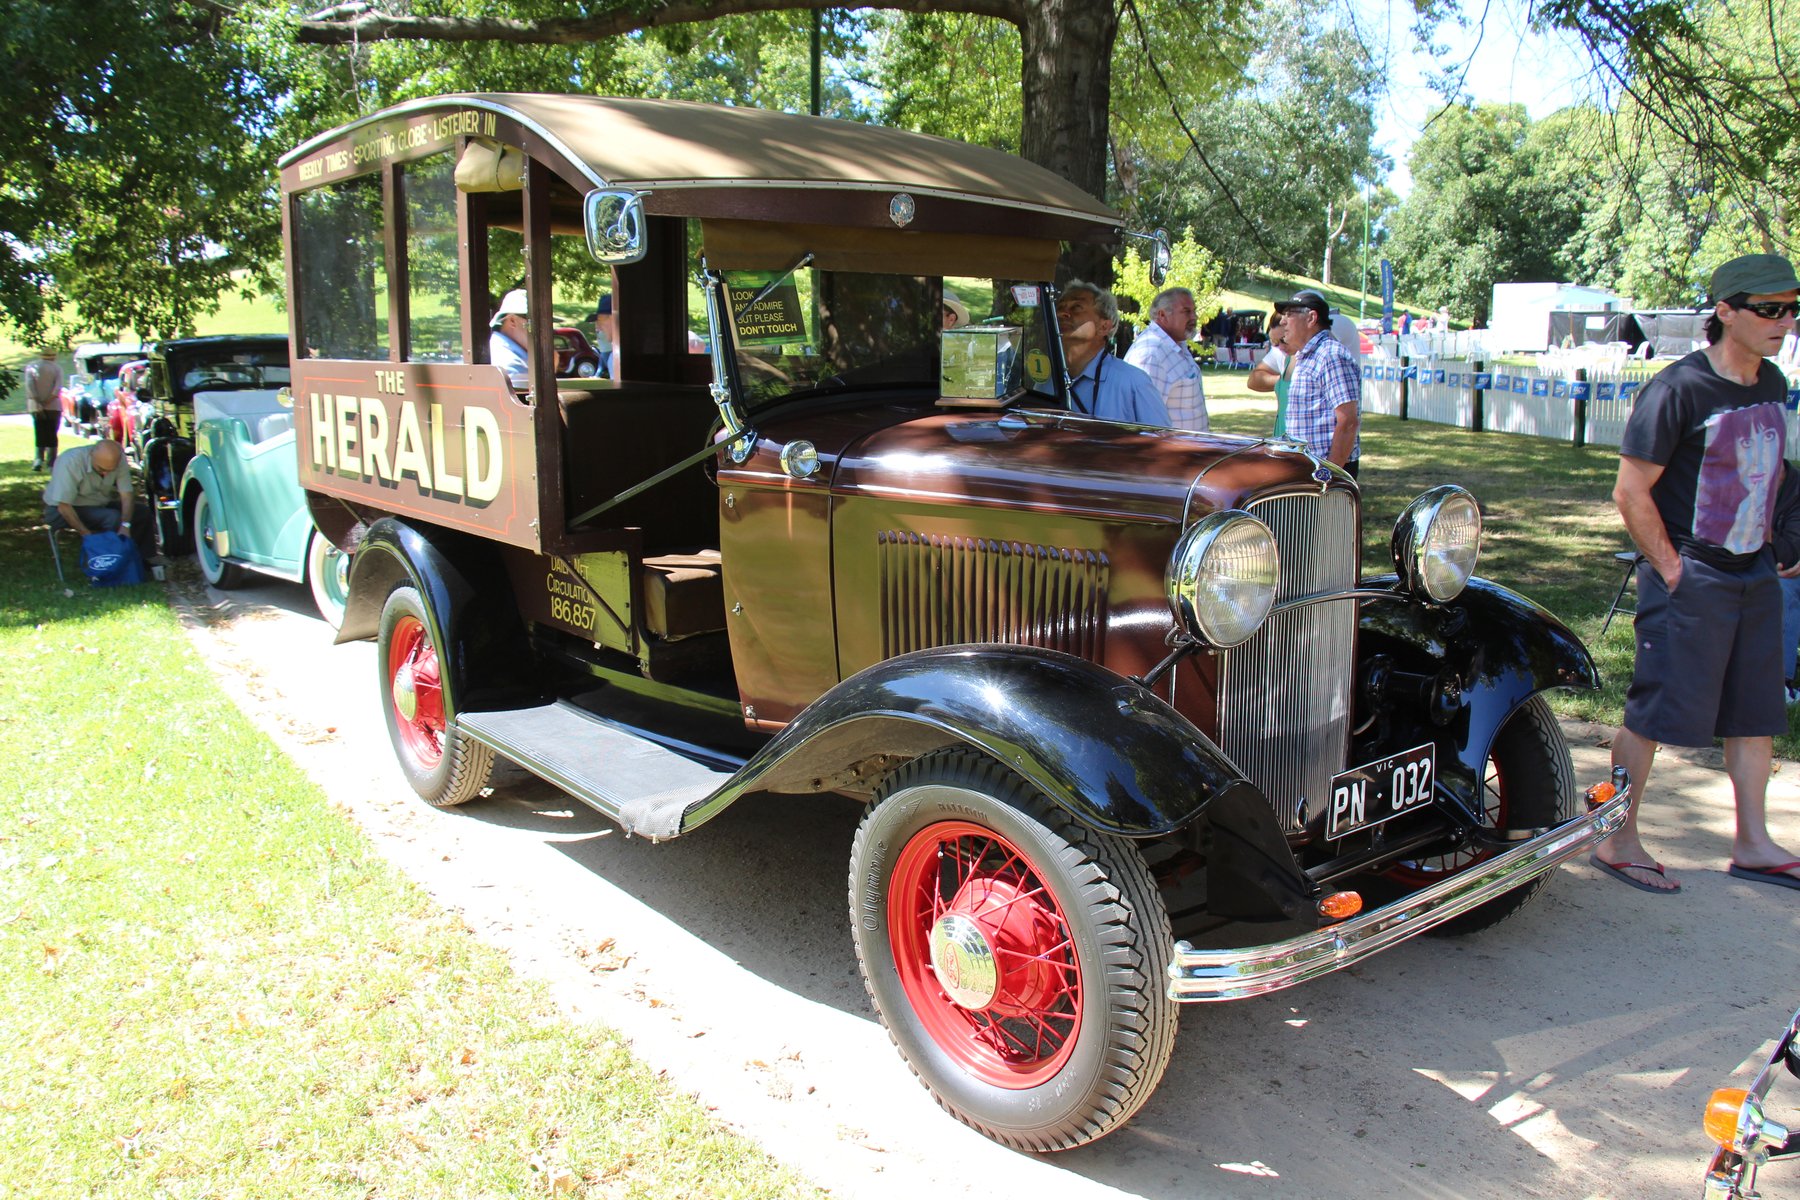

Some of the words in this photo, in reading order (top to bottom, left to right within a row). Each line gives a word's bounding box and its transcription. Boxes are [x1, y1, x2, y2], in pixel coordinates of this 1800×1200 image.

[325, 150, 348, 173] TIMES
[353, 134, 395, 165] SPORTING
[398, 124, 427, 151] GLOBE
[433, 111, 479, 140] LISTENER
[484, 112, 496, 137] IN
[731, 291, 754, 301] LOOK
[753, 301, 784, 311] ADMIRE
[754, 312, 784, 323] PLEASE
[740, 325, 765, 335] DON'T
[767, 323, 798, 333] TOUCH
[375, 370, 406, 395] THE
[310, 392, 503, 504] HERALD
[551, 595, 597, 631] 186,857
[1376, 759, 1394, 773] VIC
[1332, 780, 1366, 832] PN
[1392, 758, 1431, 810] 032
